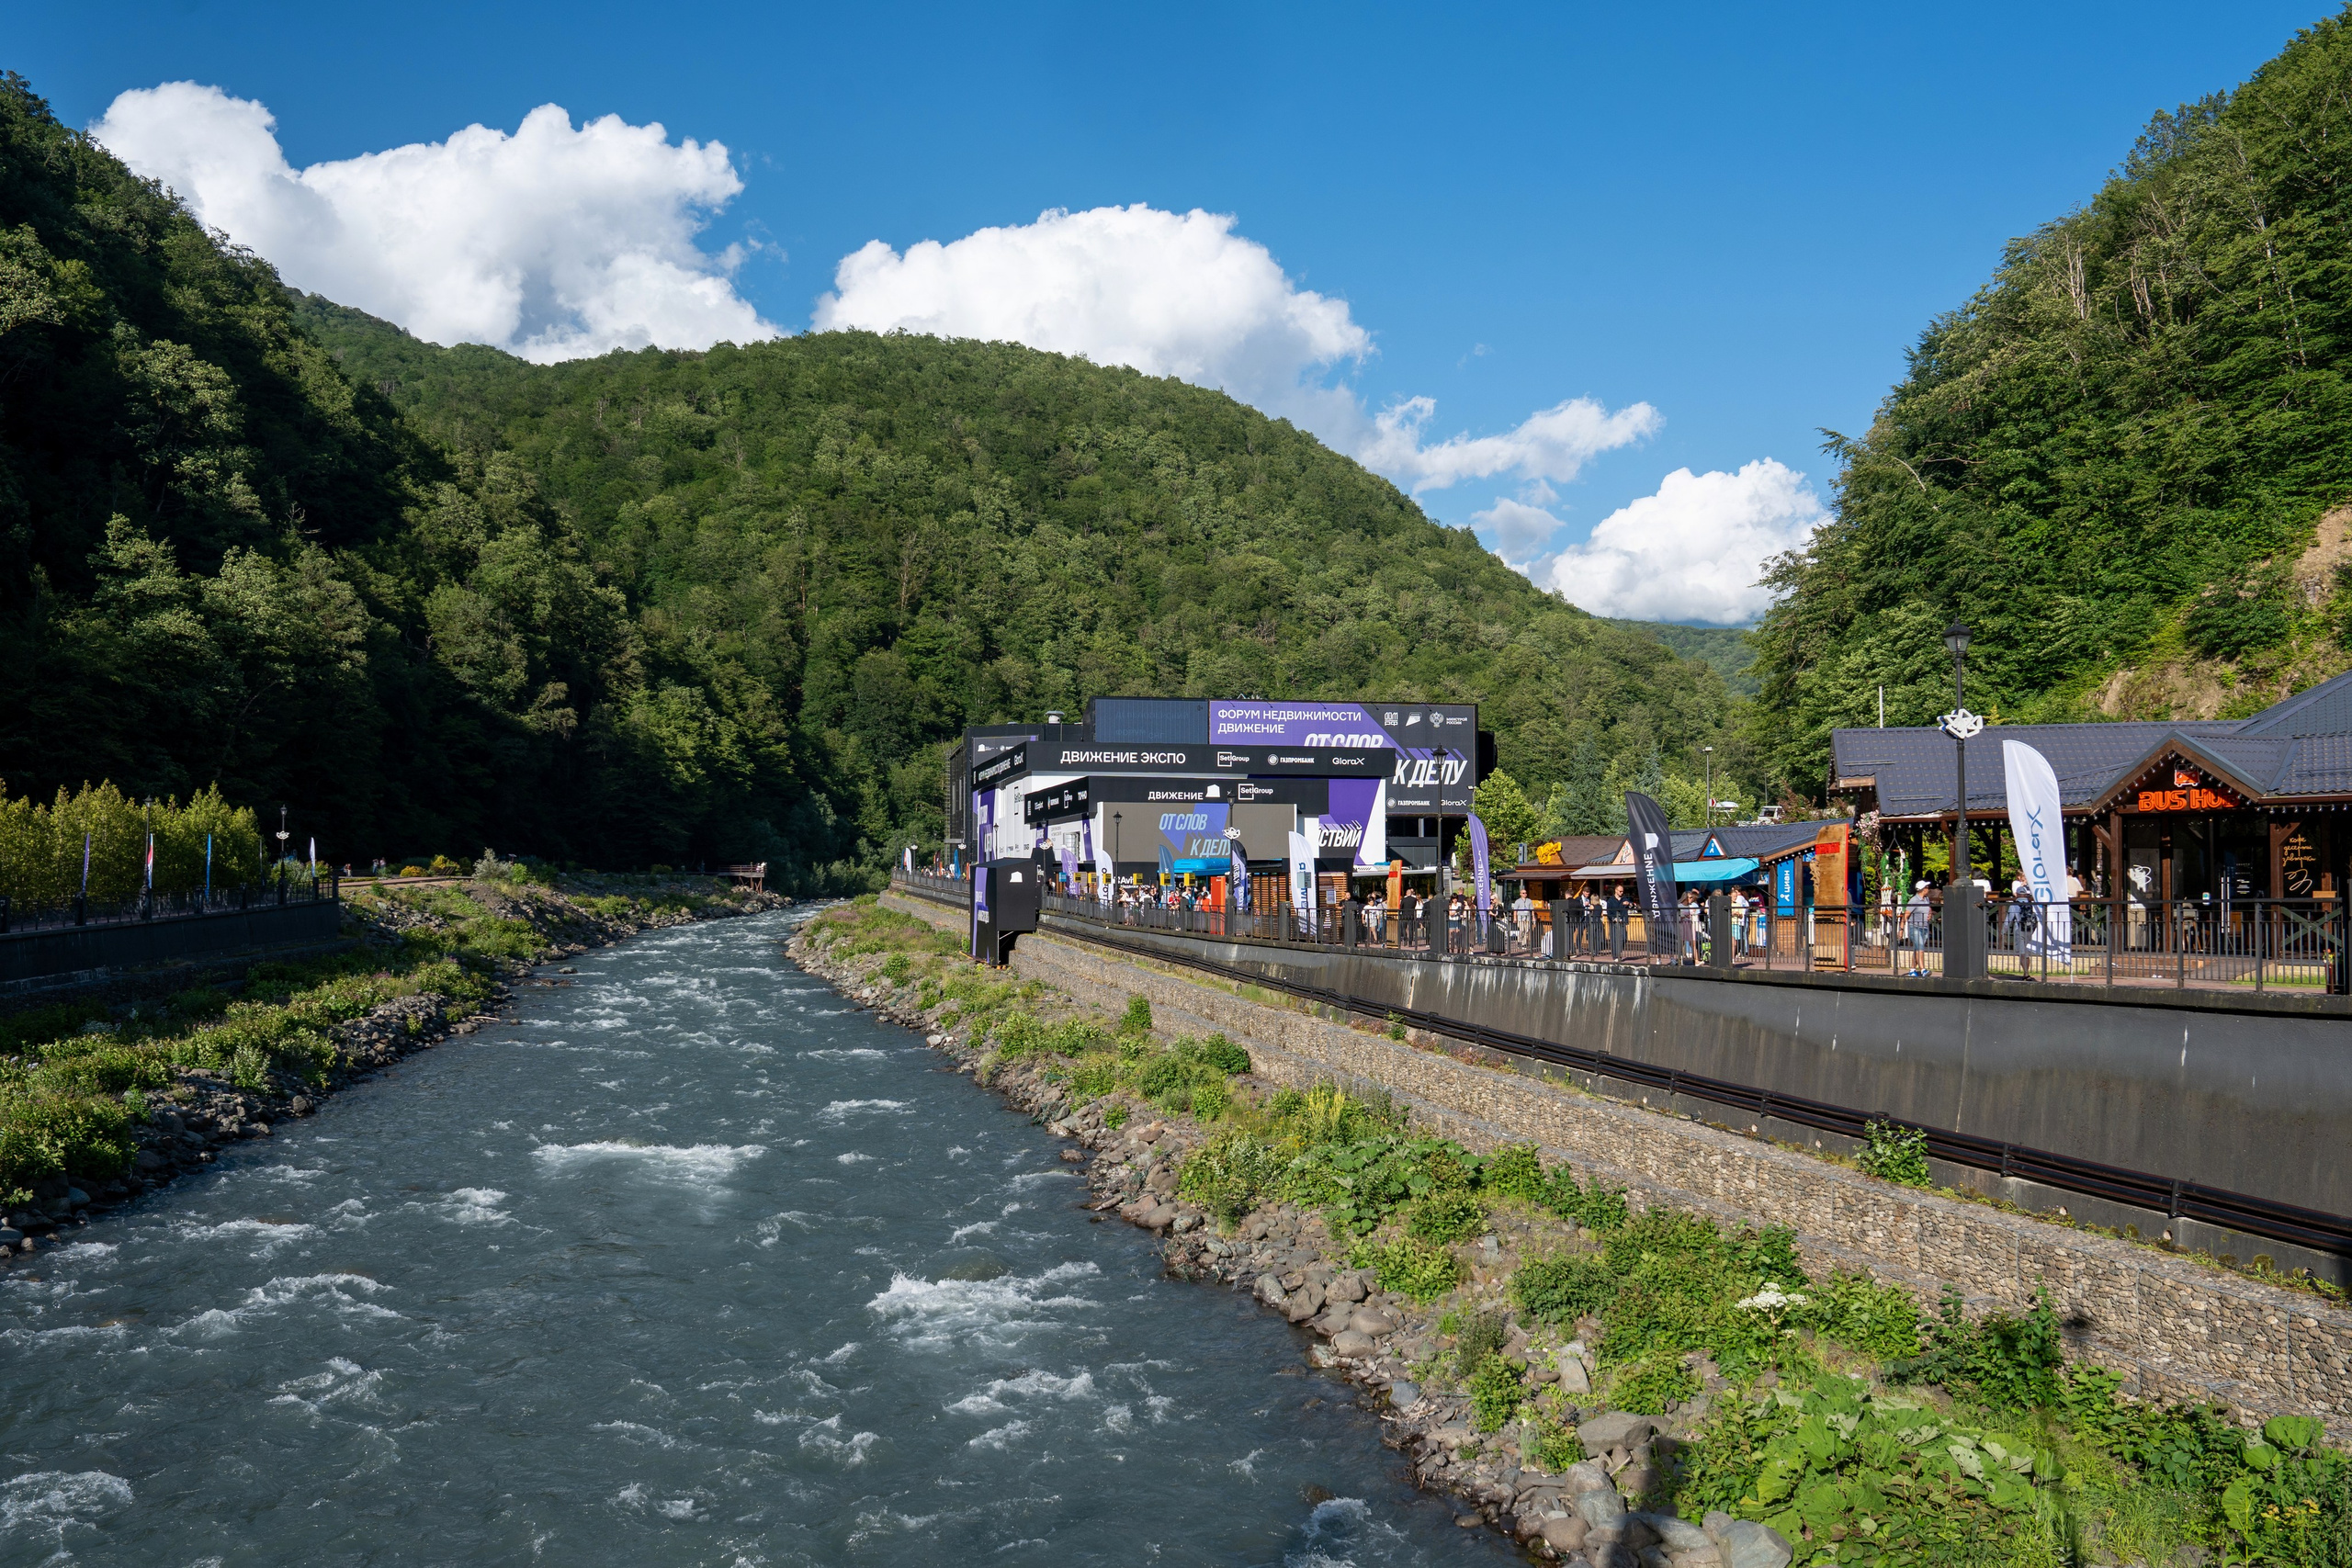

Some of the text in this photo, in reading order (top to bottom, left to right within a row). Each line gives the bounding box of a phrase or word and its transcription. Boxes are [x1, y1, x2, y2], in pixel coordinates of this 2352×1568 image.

[1217, 709, 1362, 722] ФОРУМ НЕДВИЖИМОСТИ
[1217, 723, 1285, 735] ДВИЖЕНИЕ
[1060, 750, 1186, 764] ДВИЖЕНИЕ ЭКСПО
[1332, 757, 1365, 765] GloraX
[1392, 760, 1468, 787] К ДЕЛУ
[1148, 791, 1204, 800] ДВИЖЕНИЕ
[2139, 788, 2241, 812] BUS HUB
[1159, 813, 1208, 830] ОТ СЛОВ
[2290, 834, 2307, 846] кофе
[1190, 839, 1202, 856] К
[2282, 853, 2316, 868] завтраки
